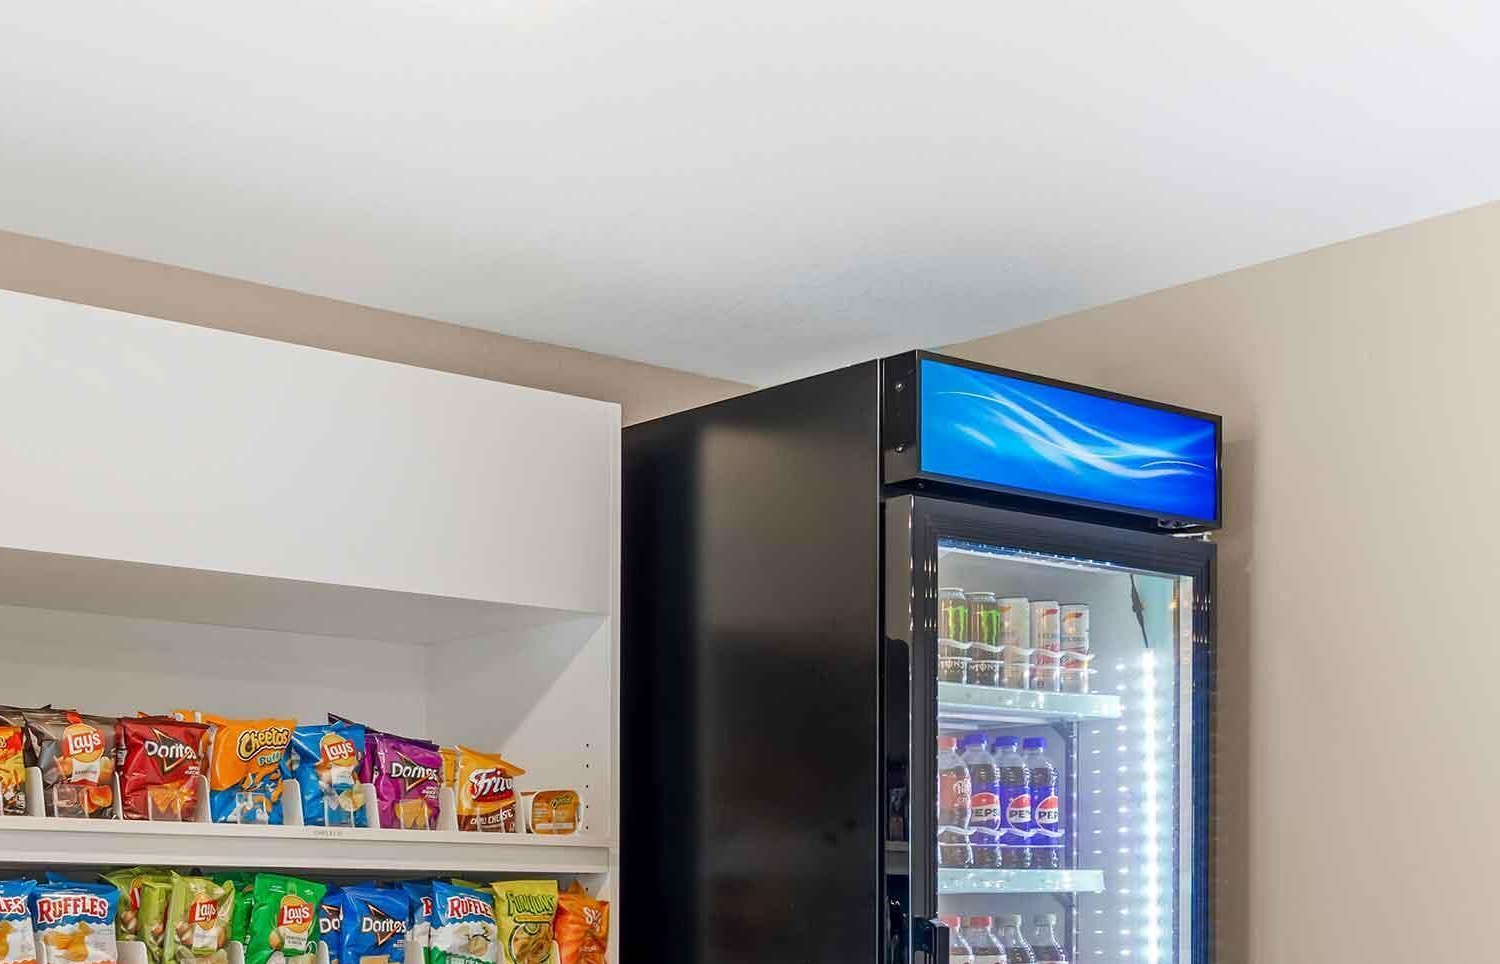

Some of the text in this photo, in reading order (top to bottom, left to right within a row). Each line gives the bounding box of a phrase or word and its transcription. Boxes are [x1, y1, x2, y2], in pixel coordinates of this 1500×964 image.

[68, 731, 101, 755] Lay's
[144, 740, 197, 760] Doritos
[238, 727, 290, 761] Cheetos
[325, 740, 355, 761] Lay's
[391, 762, 438, 782] Doritos
[38, 896, 107, 922] RUFFLES
[282, 904, 310, 924] Lay's
[361, 917, 407, 933] Doritos
